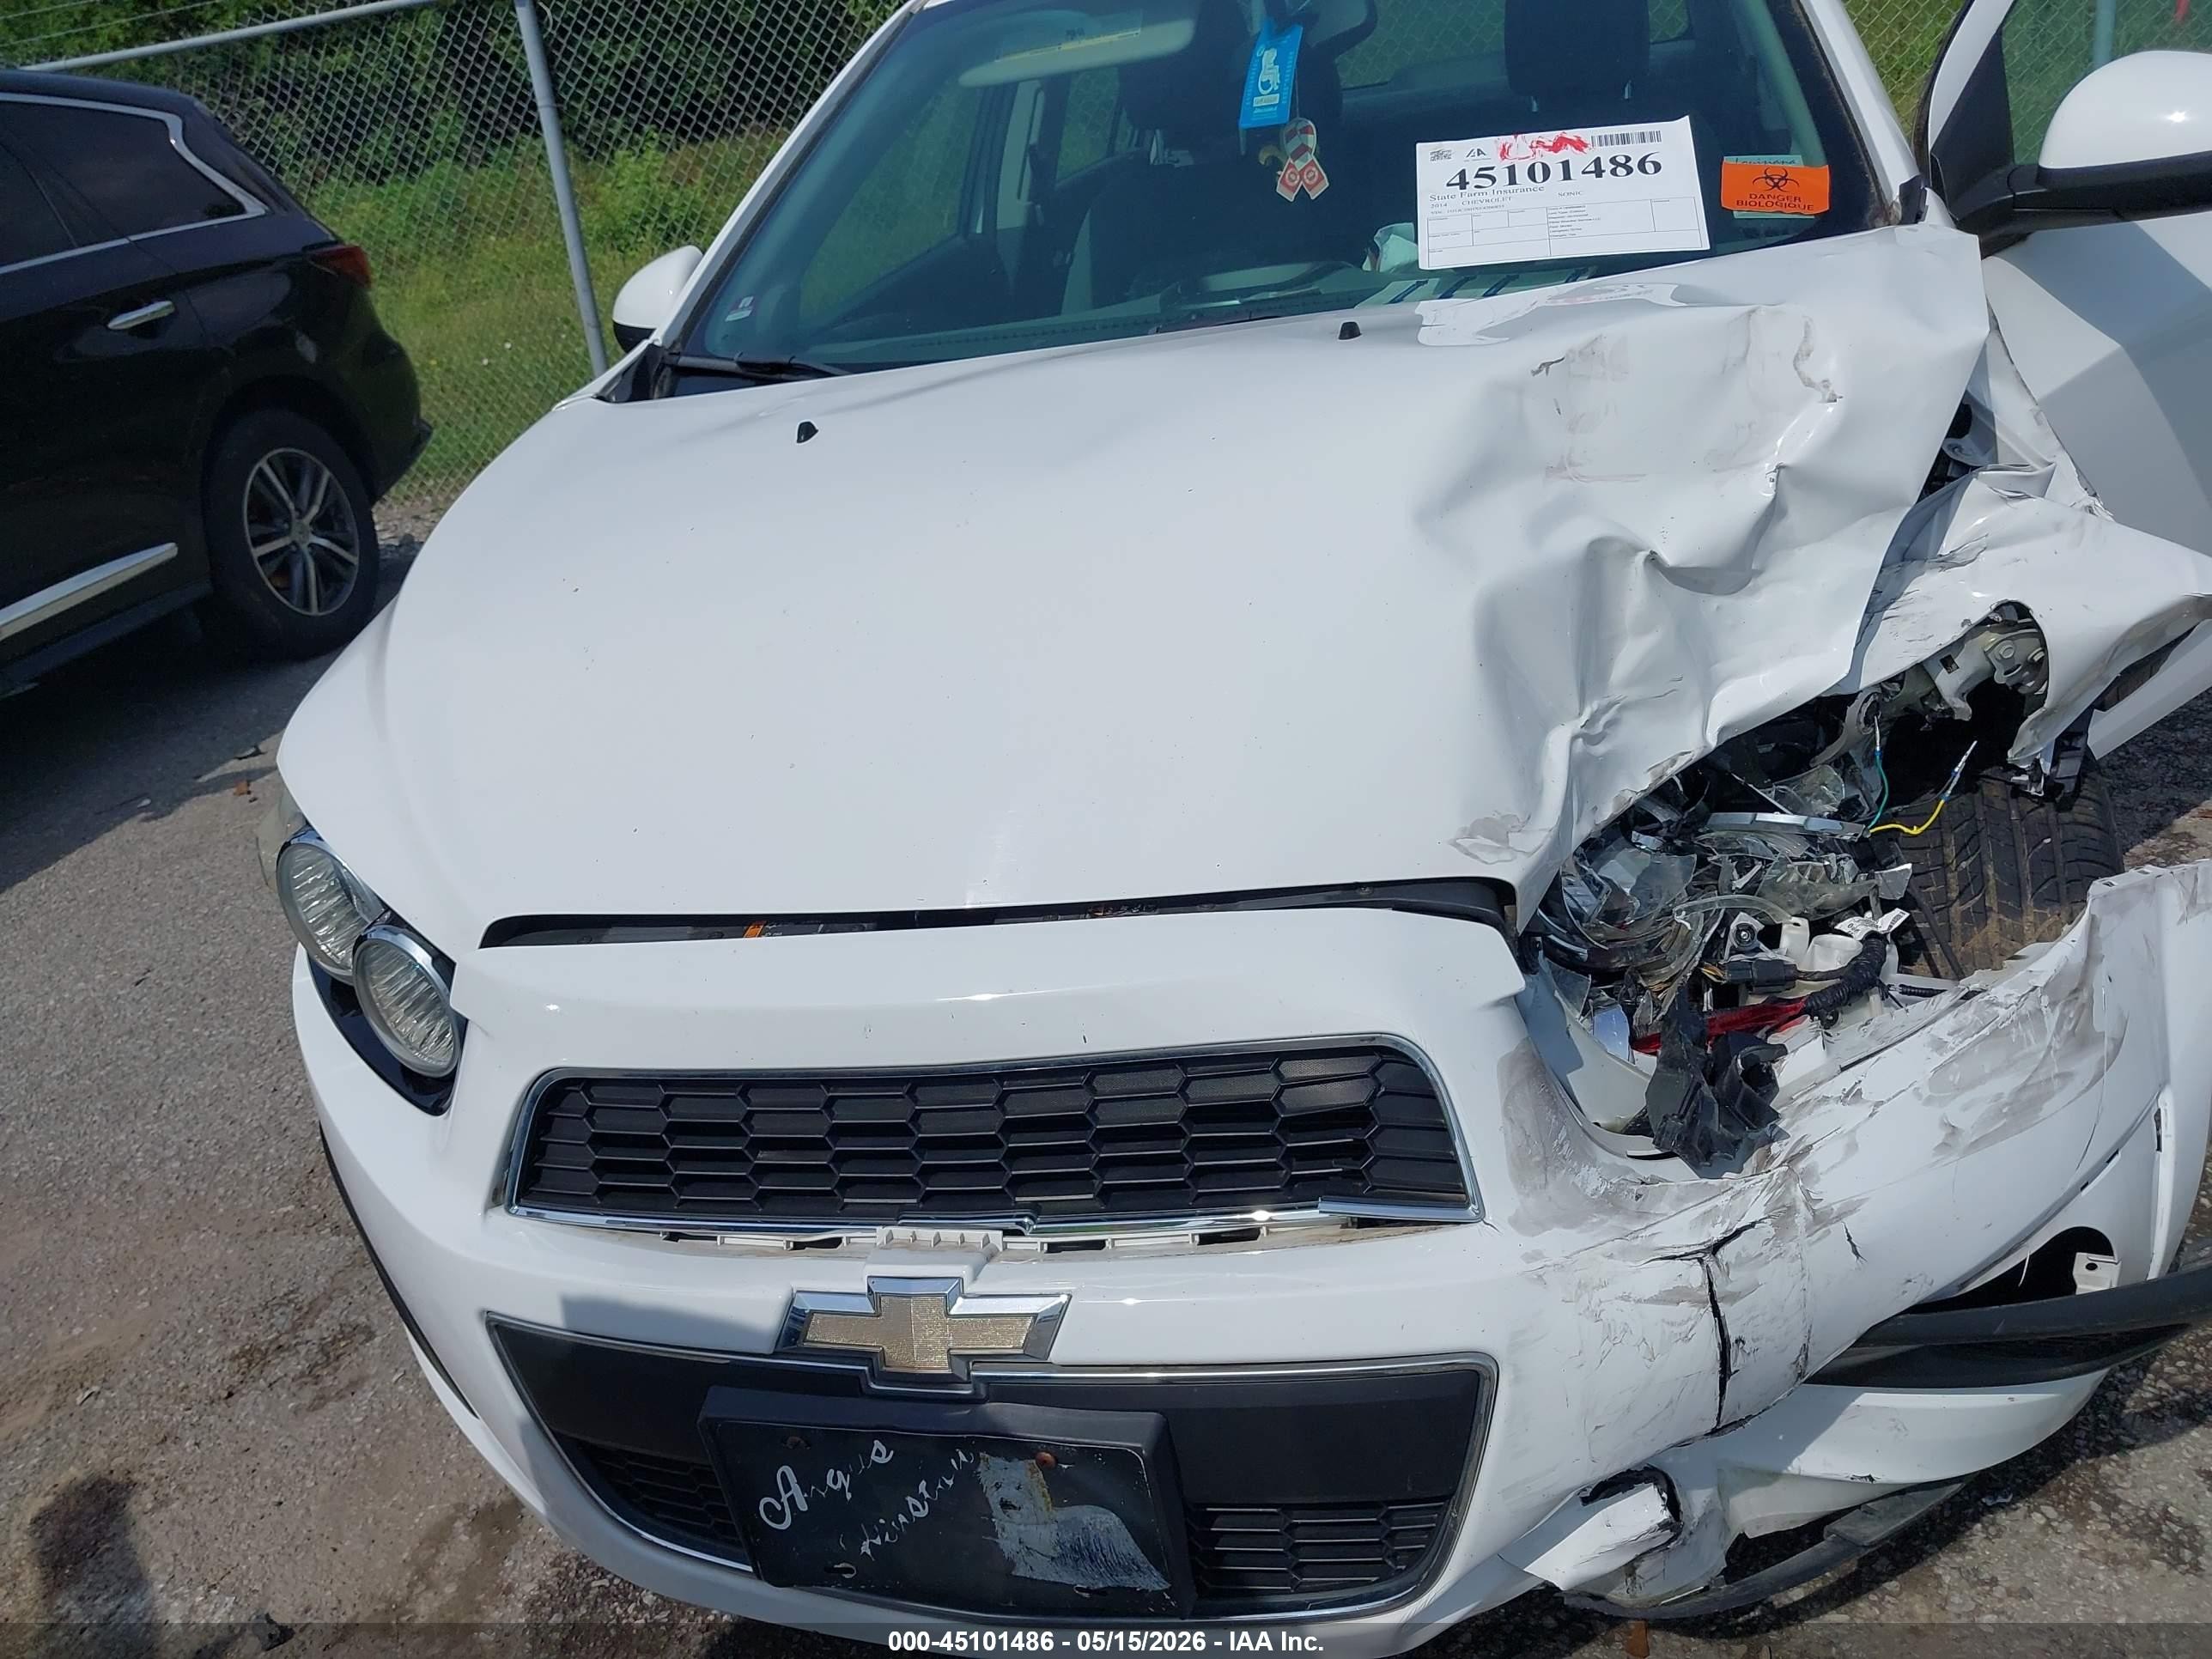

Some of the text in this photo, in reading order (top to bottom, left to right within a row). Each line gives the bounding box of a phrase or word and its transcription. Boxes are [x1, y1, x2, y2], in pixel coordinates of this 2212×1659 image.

[1446, 151, 1662, 190] 45101486
[1492, 185, 1545, 195] Insurance
[1462, 196, 1511, 205] CHEVROLET
[1748, 193, 1802, 203] DANGER
[1735, 200, 1814, 211] BIOLOGIQUE
